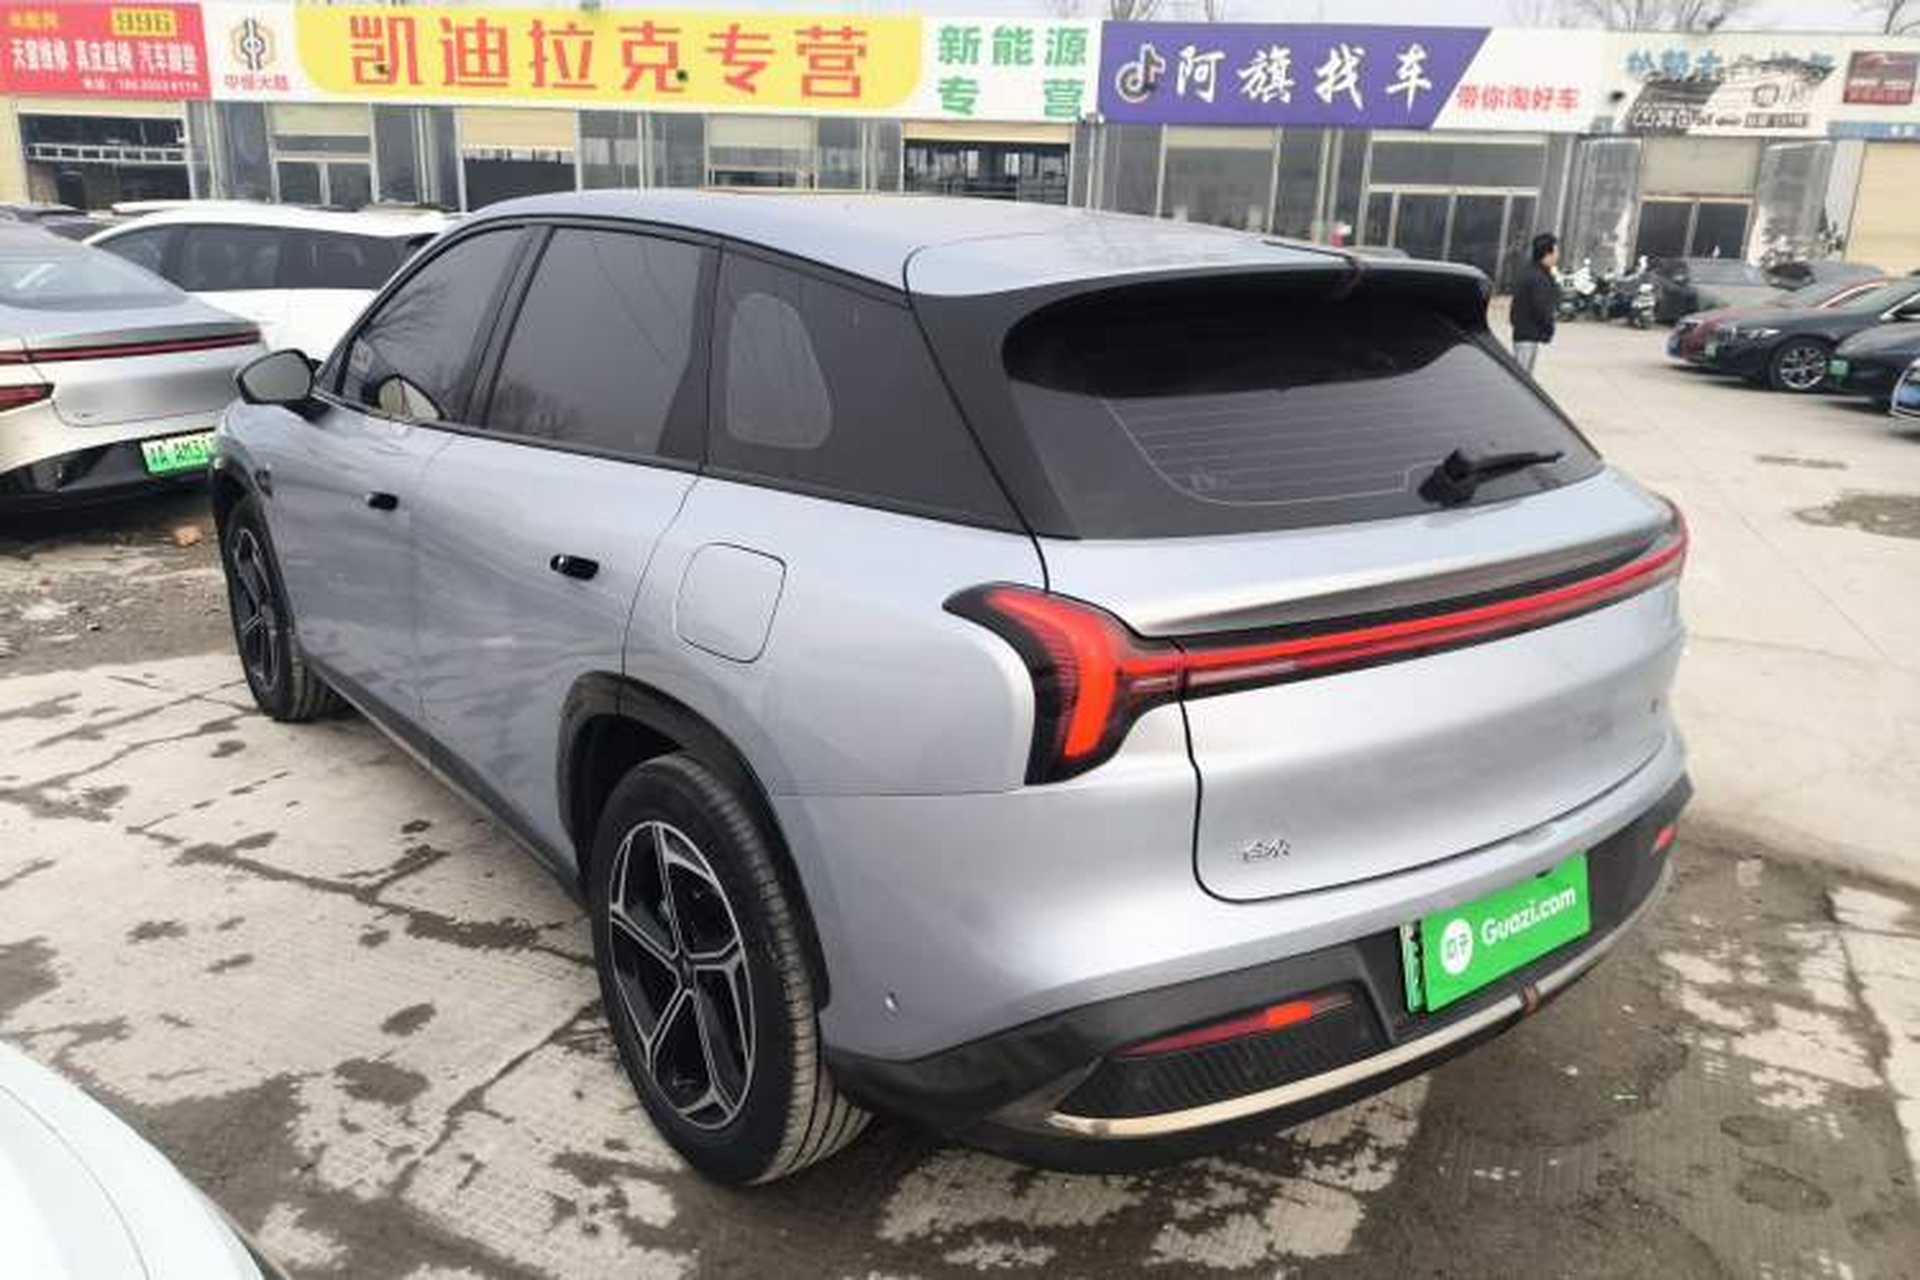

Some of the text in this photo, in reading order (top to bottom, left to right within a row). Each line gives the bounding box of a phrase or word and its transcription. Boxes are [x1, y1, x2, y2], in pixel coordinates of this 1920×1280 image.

[350, 16, 868, 98] 凯迪拉克专营
[937, 25, 1088, 66] 新能源
[1175, 44, 1433, 112] 阿旗找车
[1456, 84, 1581, 112] 带你淘好车
